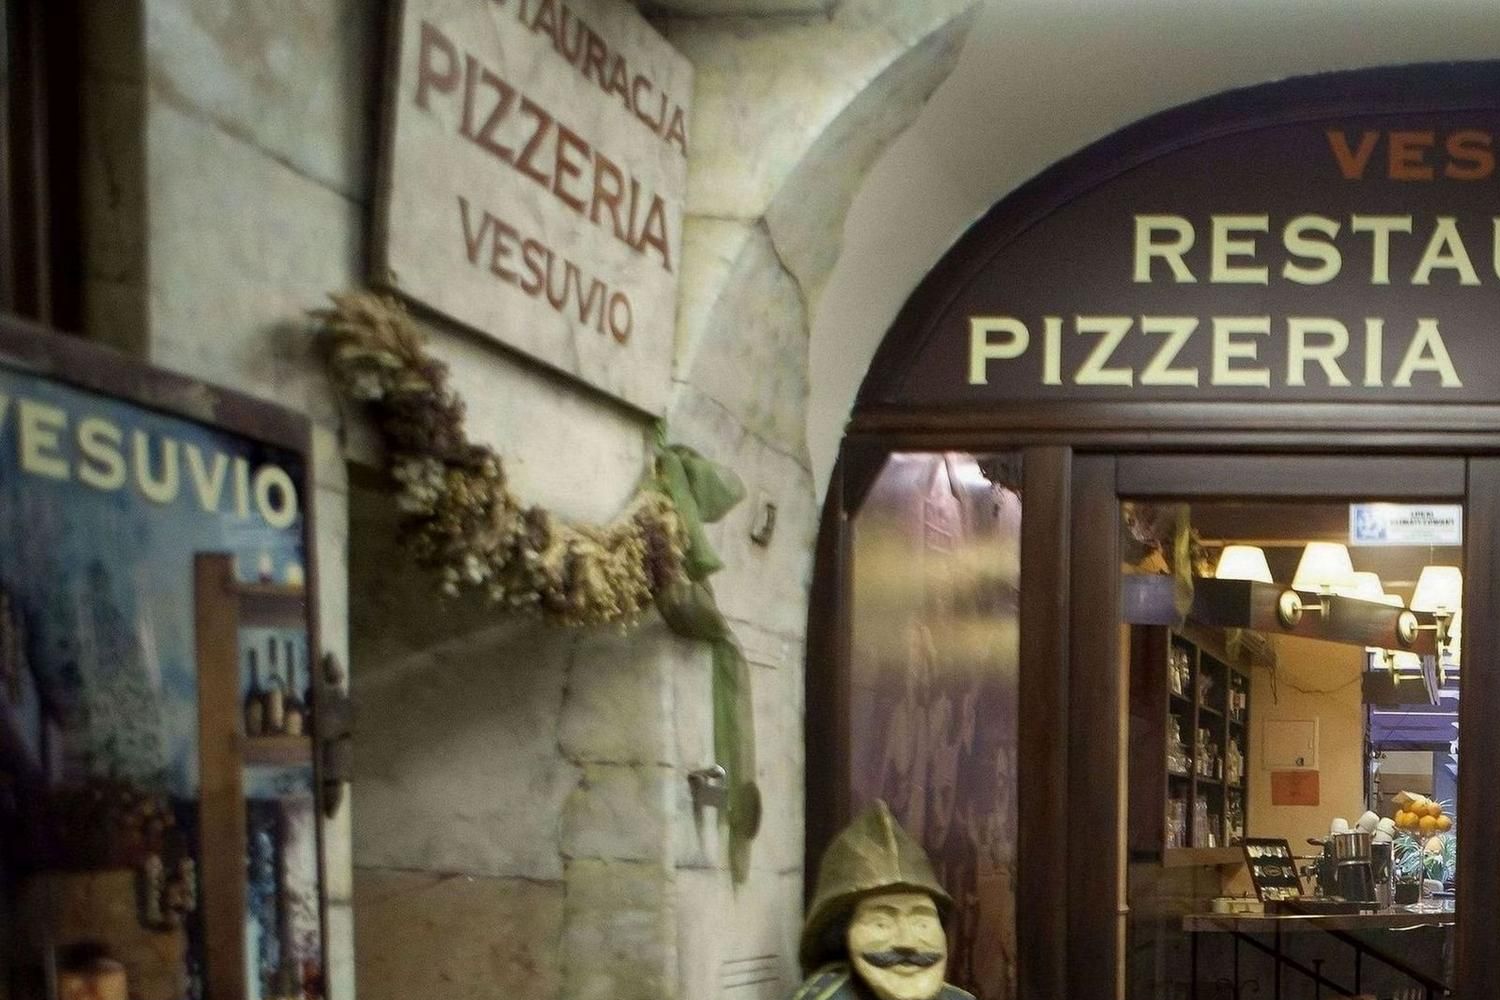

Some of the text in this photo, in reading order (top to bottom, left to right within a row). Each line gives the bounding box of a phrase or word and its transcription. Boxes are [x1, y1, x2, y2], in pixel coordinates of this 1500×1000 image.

[413, 20, 672, 273] PIZZERIA
[458, 195, 633, 345] VESUVIO
[968, 315, 1463, 389] PIZZERIA
